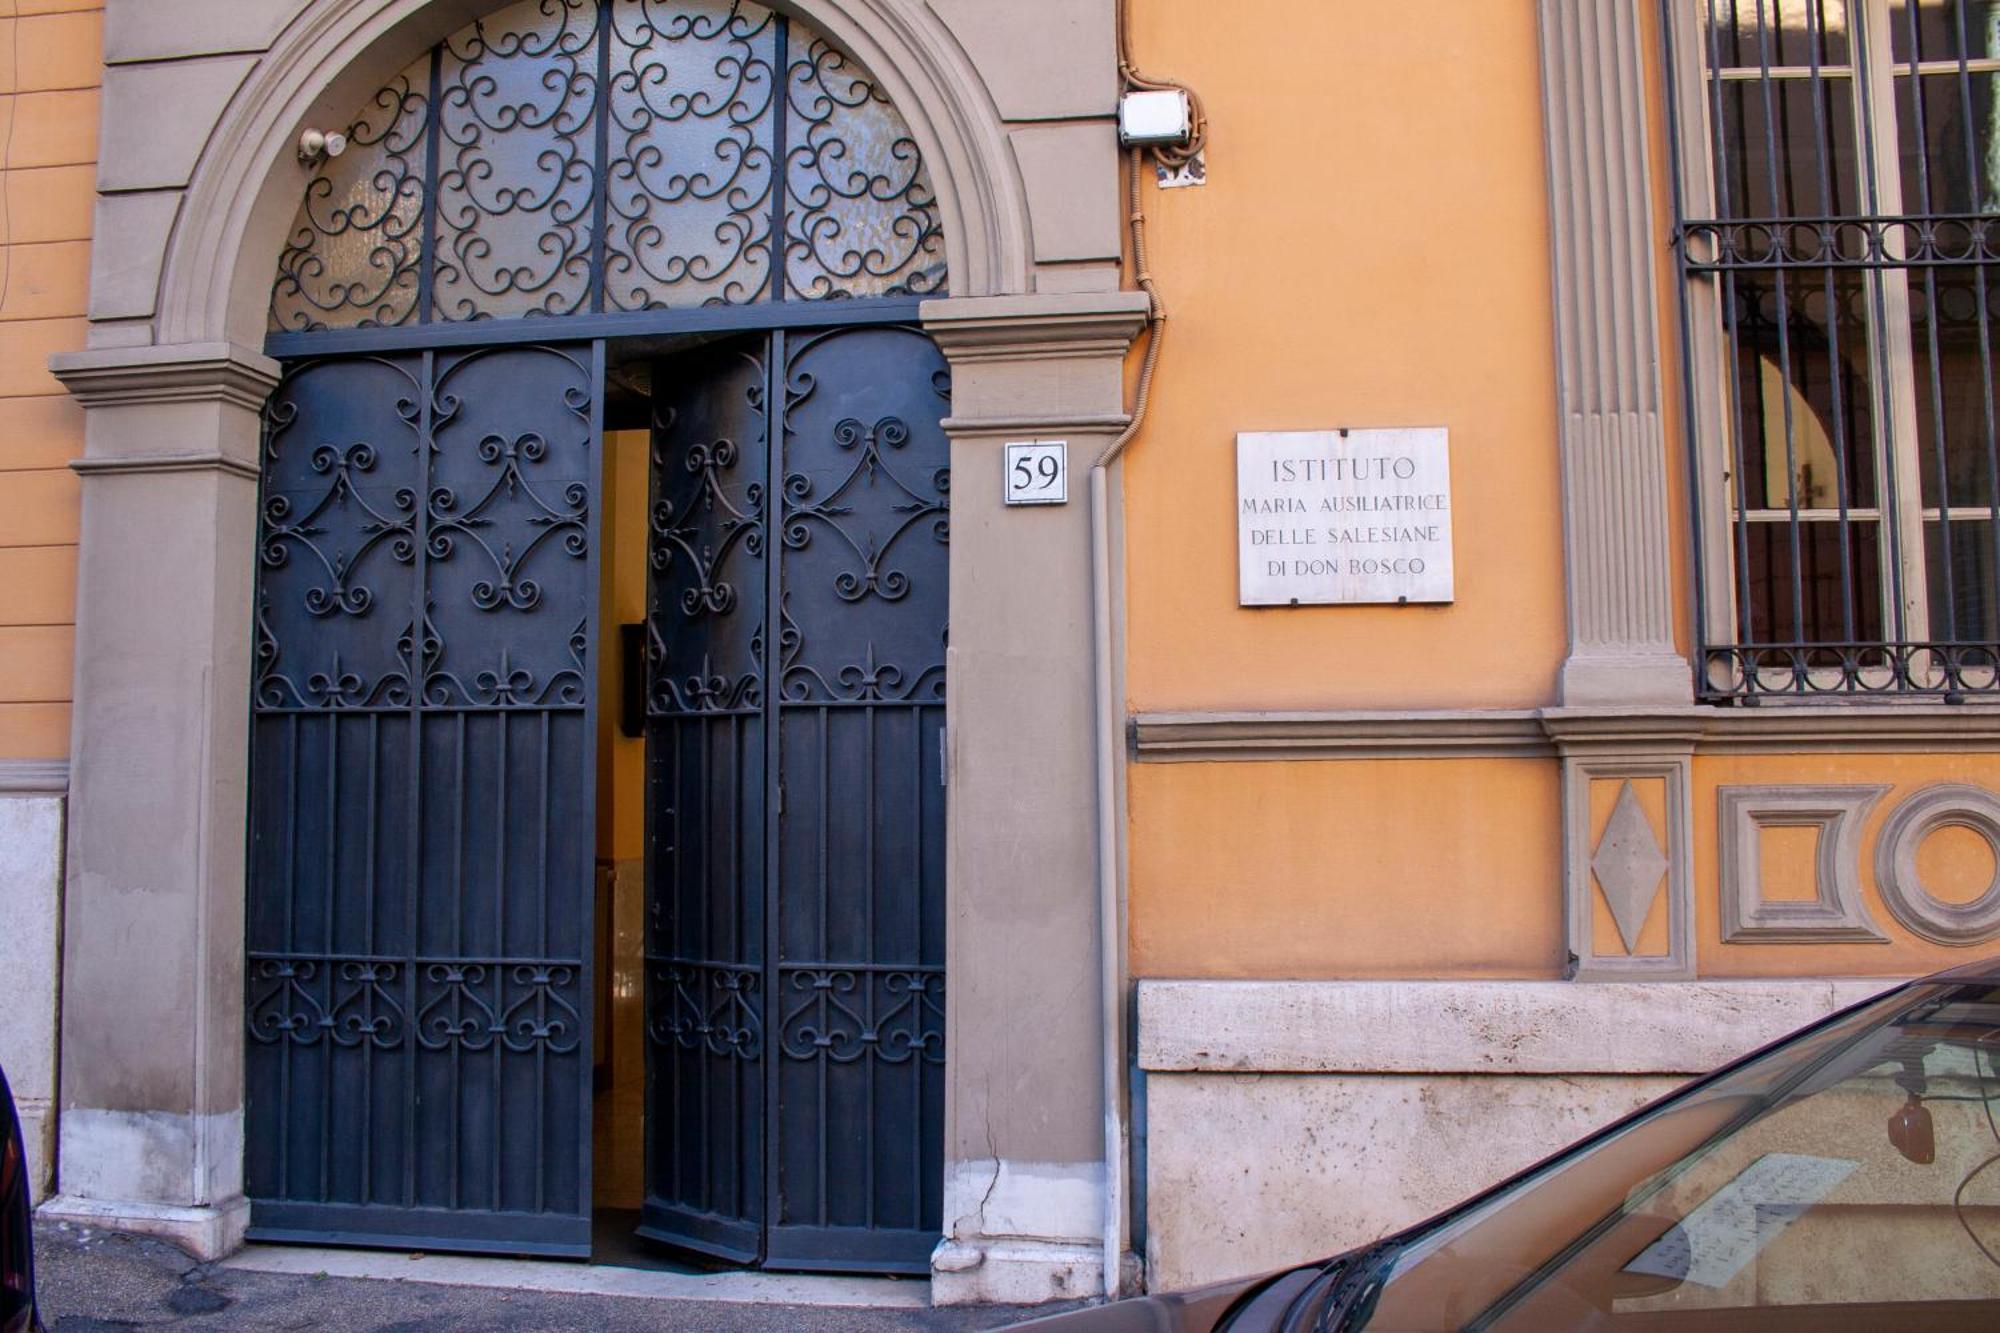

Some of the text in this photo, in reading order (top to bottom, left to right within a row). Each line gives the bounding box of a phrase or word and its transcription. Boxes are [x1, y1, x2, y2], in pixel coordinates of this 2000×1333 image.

[1014, 455, 1058, 490] 59
[1273, 457, 1415, 482] ISTITUTO
[1242, 495, 1448, 514] MARIA AUSILIATRICE
[1251, 526, 1440, 545] DELLE SALESIANE
[1268, 558, 1425, 577] DI DON BOSCO
